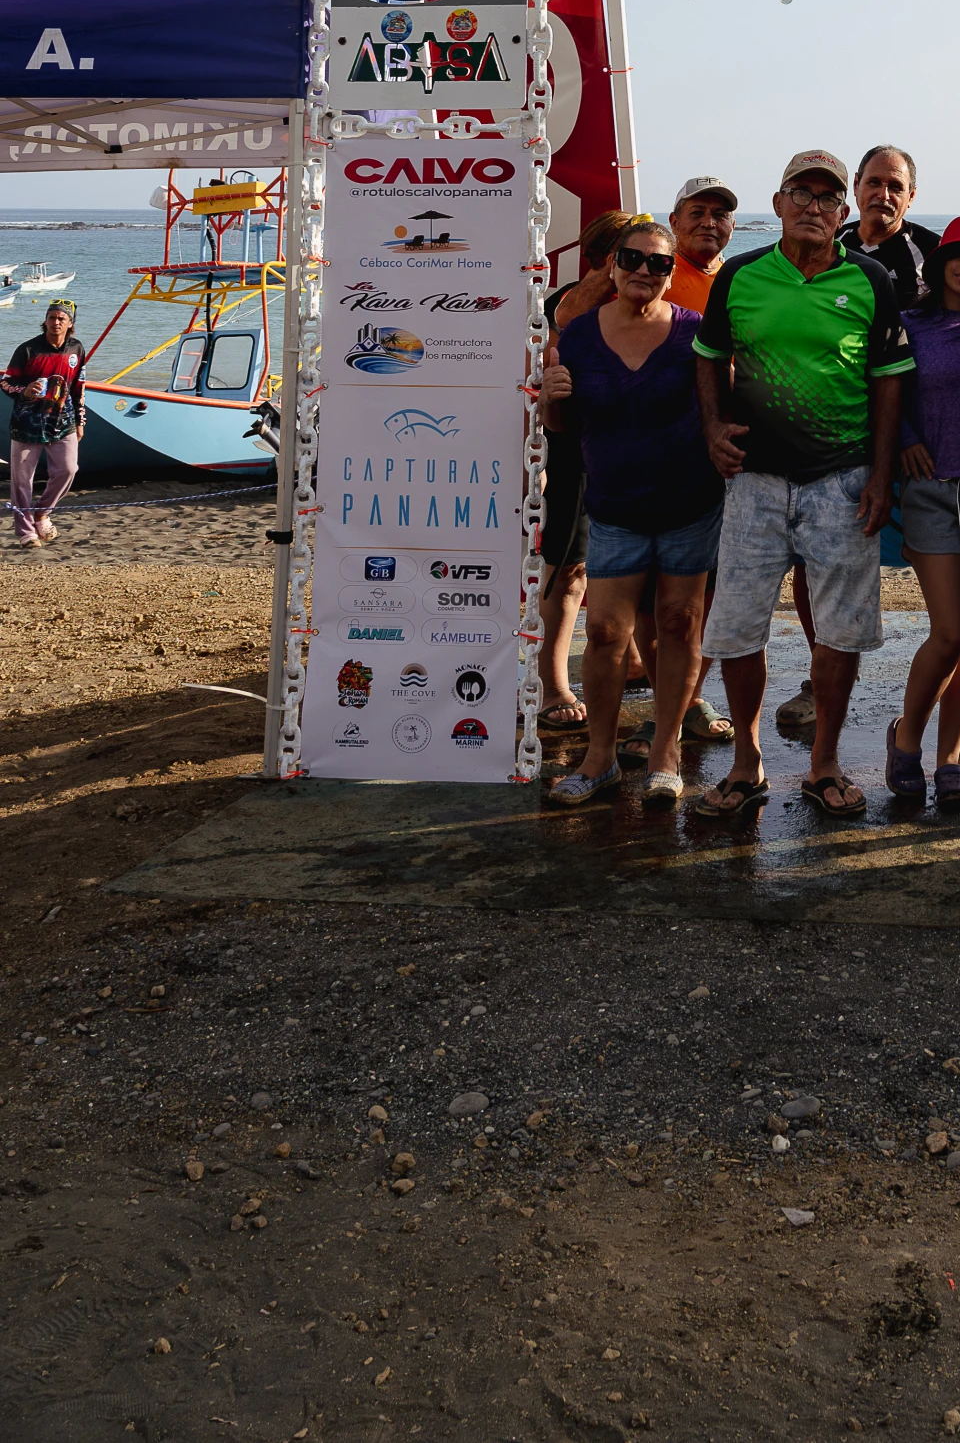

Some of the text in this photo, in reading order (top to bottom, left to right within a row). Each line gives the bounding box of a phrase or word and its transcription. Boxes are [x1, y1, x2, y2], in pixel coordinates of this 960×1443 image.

[343, 157, 516, 185] CALVO
[349, 186, 513, 199] @rotuloscalvopanama
[360, 257, 492, 268] Cébaco CoriMar Home
[340, 292, 414, 312] Kava
[425, 337, 493, 347] Constructora
[425, 351, 493, 364] los magníficos
[344, 456, 501, 485] CAPTURAS
[343, 491, 500, 529] PANAMÁ
[450, 564, 492, 581] VFS
[353, 599, 403, 607] SANSARA
[437, 591, 491, 607] sona
[348, 627, 406, 642] DANIEL
[430, 632, 492, 644] KAMBUTE
[455, 663, 488, 674] MONACO
[390, 689, 437, 698] THE COVE
